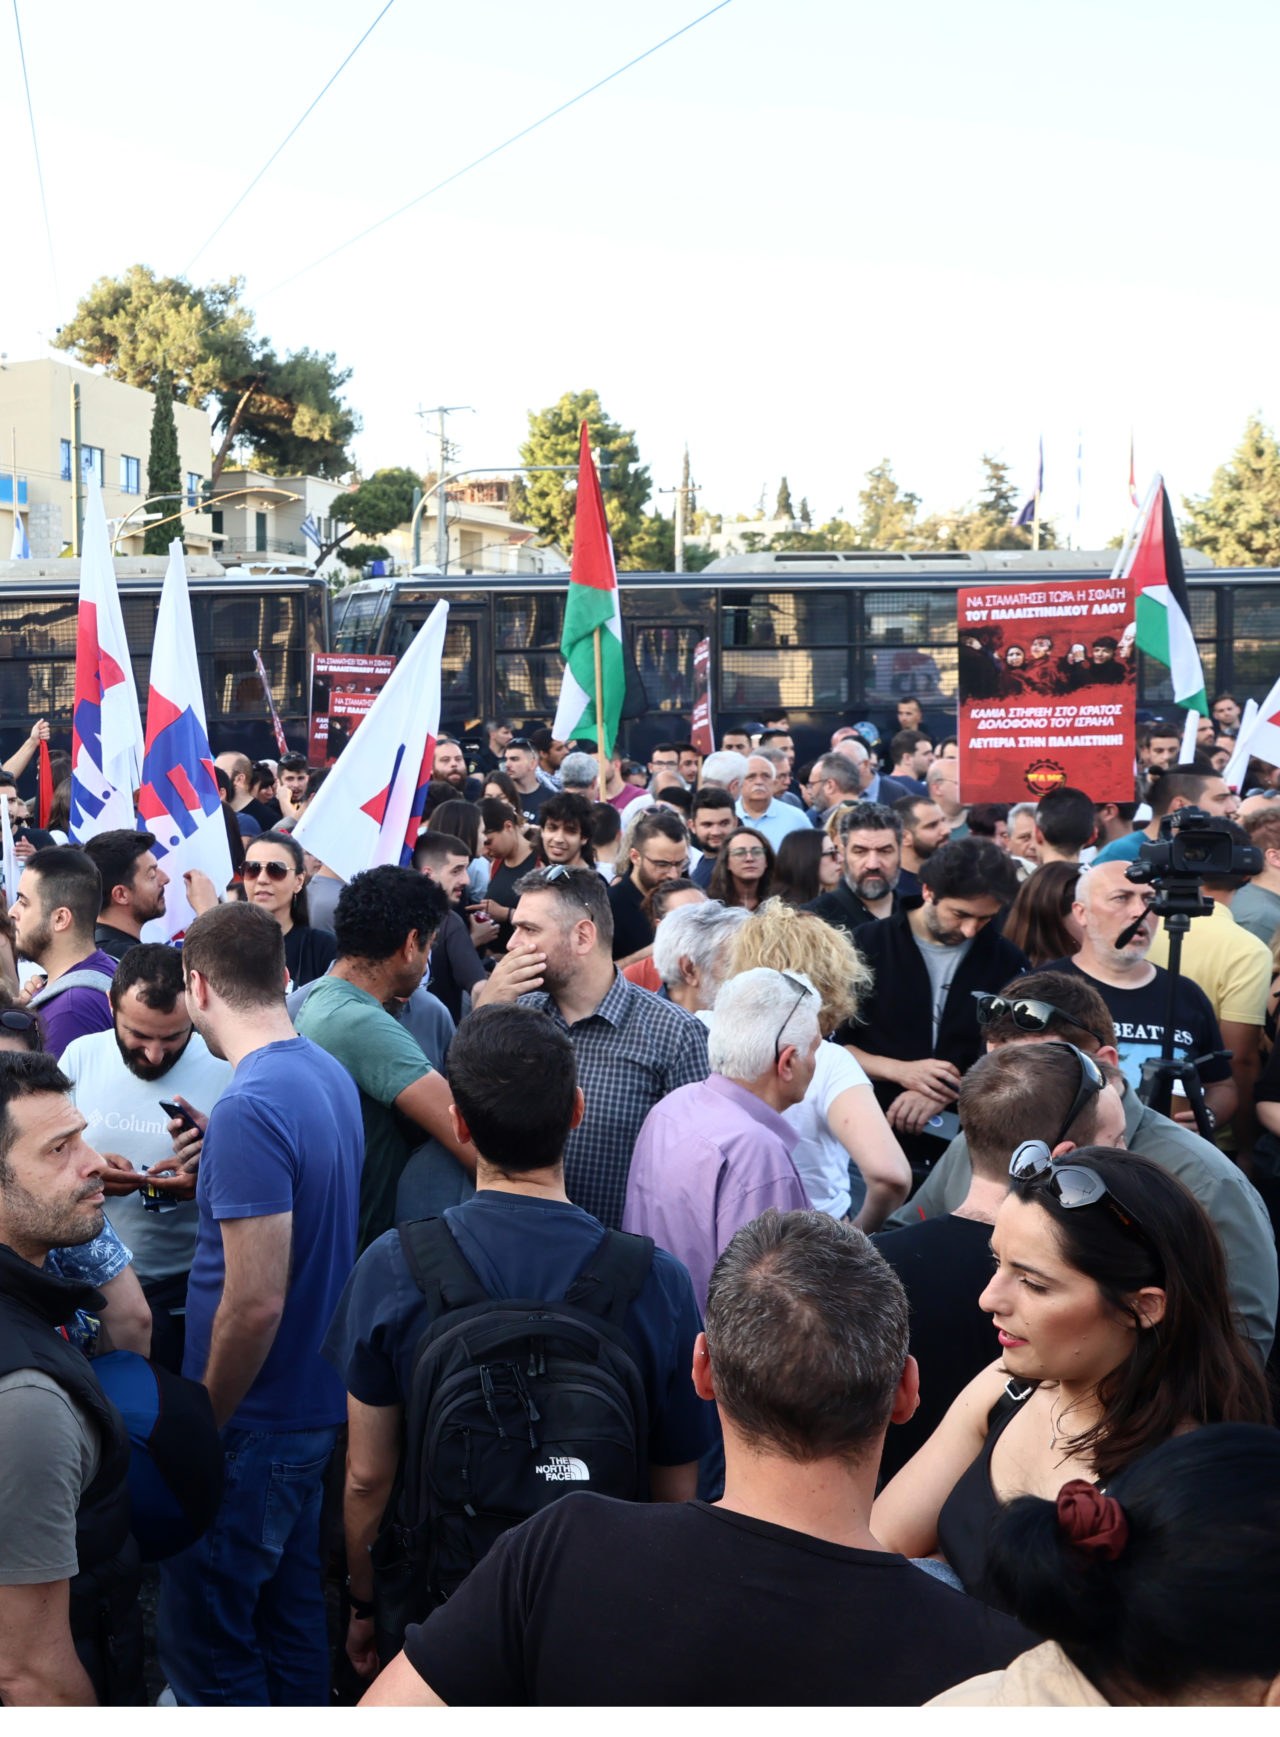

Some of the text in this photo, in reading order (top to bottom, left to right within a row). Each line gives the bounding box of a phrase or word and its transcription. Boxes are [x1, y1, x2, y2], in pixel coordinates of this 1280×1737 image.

[966, 587, 1126, 608] ΝΑ ΣΤΑΜΑΤΗΣΕΙ ΤΩΡΑ Η ΣΦΑΓΗ
[965, 602, 1127, 622] ΤΟΥ ΠΑΛΑΙΣΤΙΝΙΑΚΟΥ ΛΑΟΥ
[970, 704, 1123, 719] ΚΑΜΙΑ ΣΤΗΡΙΞΗ ΣΤΟ ΚΡΑΤΟΣ
[977, 716, 1115, 730] ΔΟΛΟΦΟΝΟ ΤΟΥ ΙΣΡΑΗΛ
[969, 734, 1123, 749] ΛΕΥΤΕΡΙΑ ΣΤΗΝ ΠΑΛΑΙΣΤΙΝΗ!
[1112, 1021, 1194, 1046] BEATES
[549, 1456, 570, 1465] THE
[535, 1464, 571, 1474] NORTH
[545, 1472, 572, 1481] FACE
